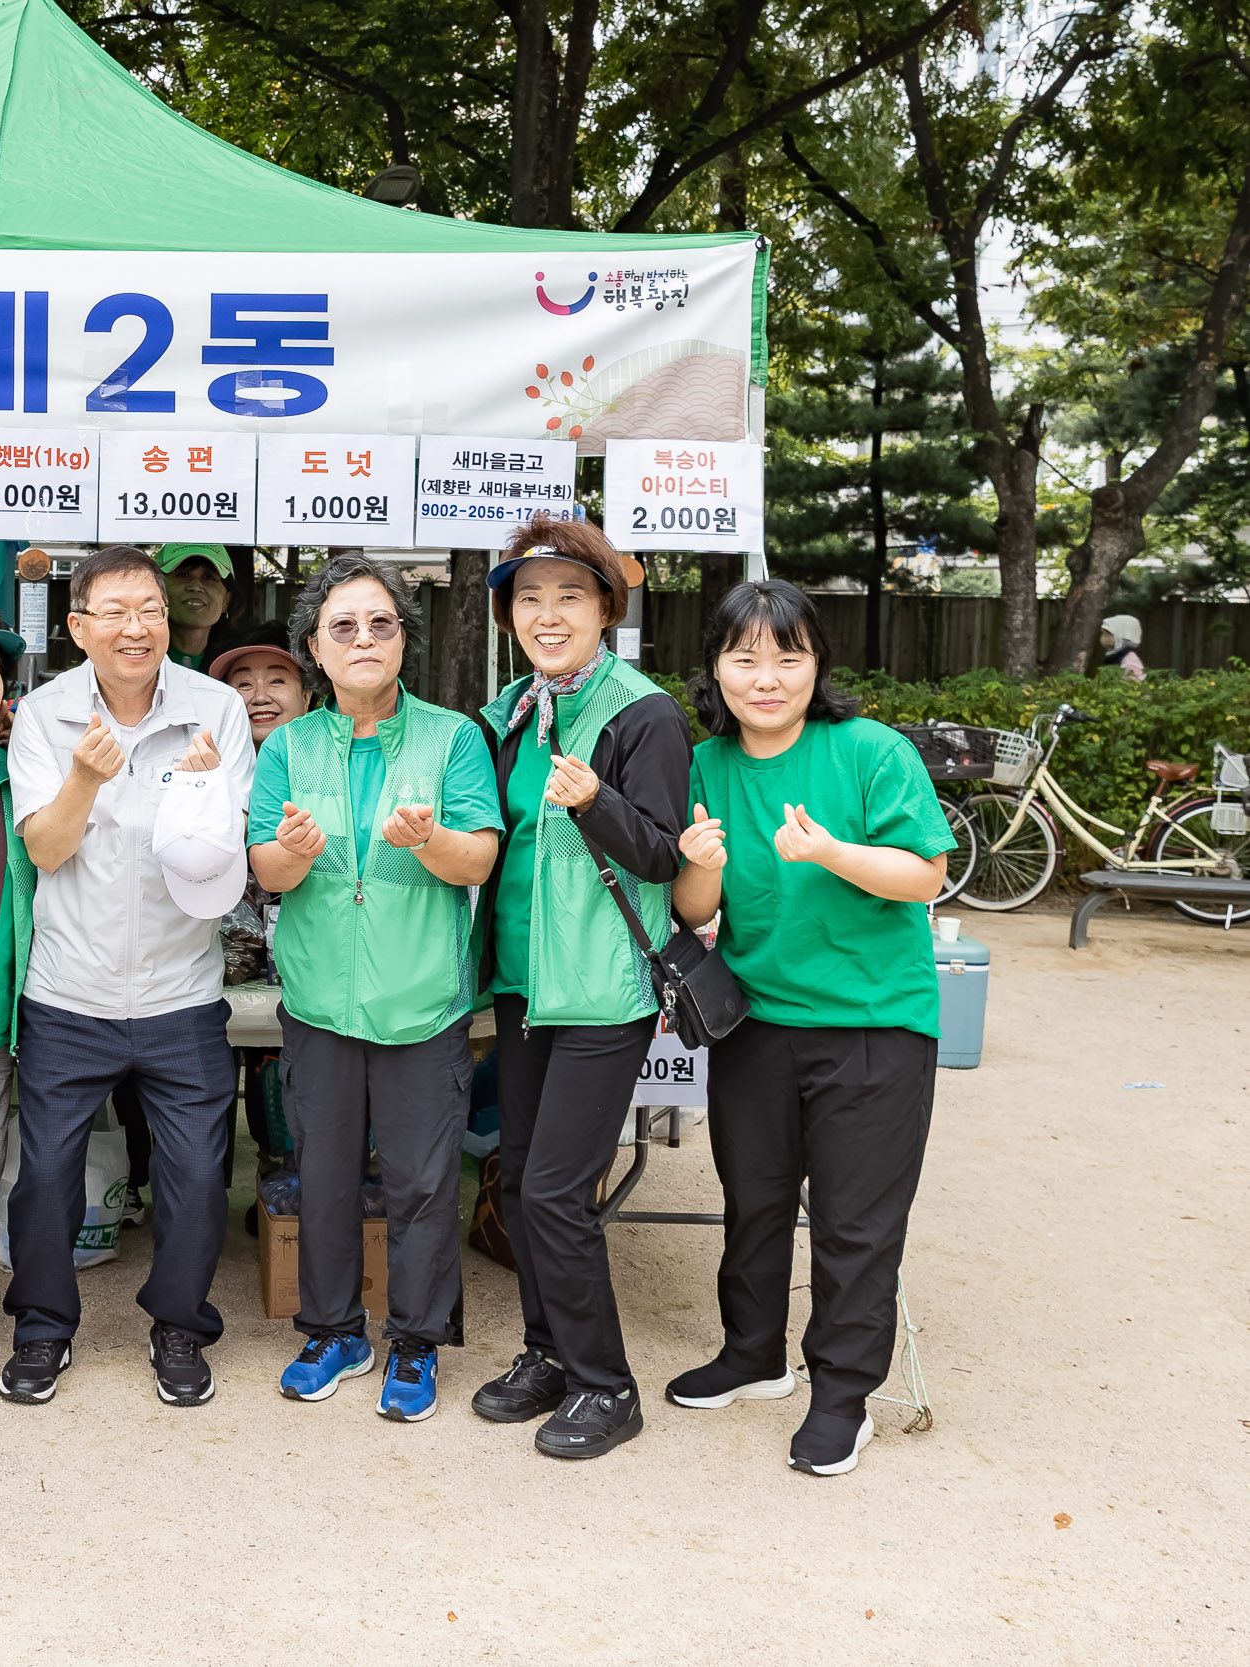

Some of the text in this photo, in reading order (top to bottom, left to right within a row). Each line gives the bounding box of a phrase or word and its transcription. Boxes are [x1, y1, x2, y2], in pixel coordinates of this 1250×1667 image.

[605, 269, 689, 287] 소통하며 발전하는
[603, 284, 689, 311] 행복광진
[452, 450, 544, 471] 새마을금고
[653, 449, 716, 471] 복숭아
[421, 478, 572, 500] (제향란 새마을부녀회)
[641, 475, 728, 498] 아이스티
[118, 492, 238, 519] 13,000원
[285, 495, 388, 522] 1,000원
[632, 507, 737, 533] 2,000원
